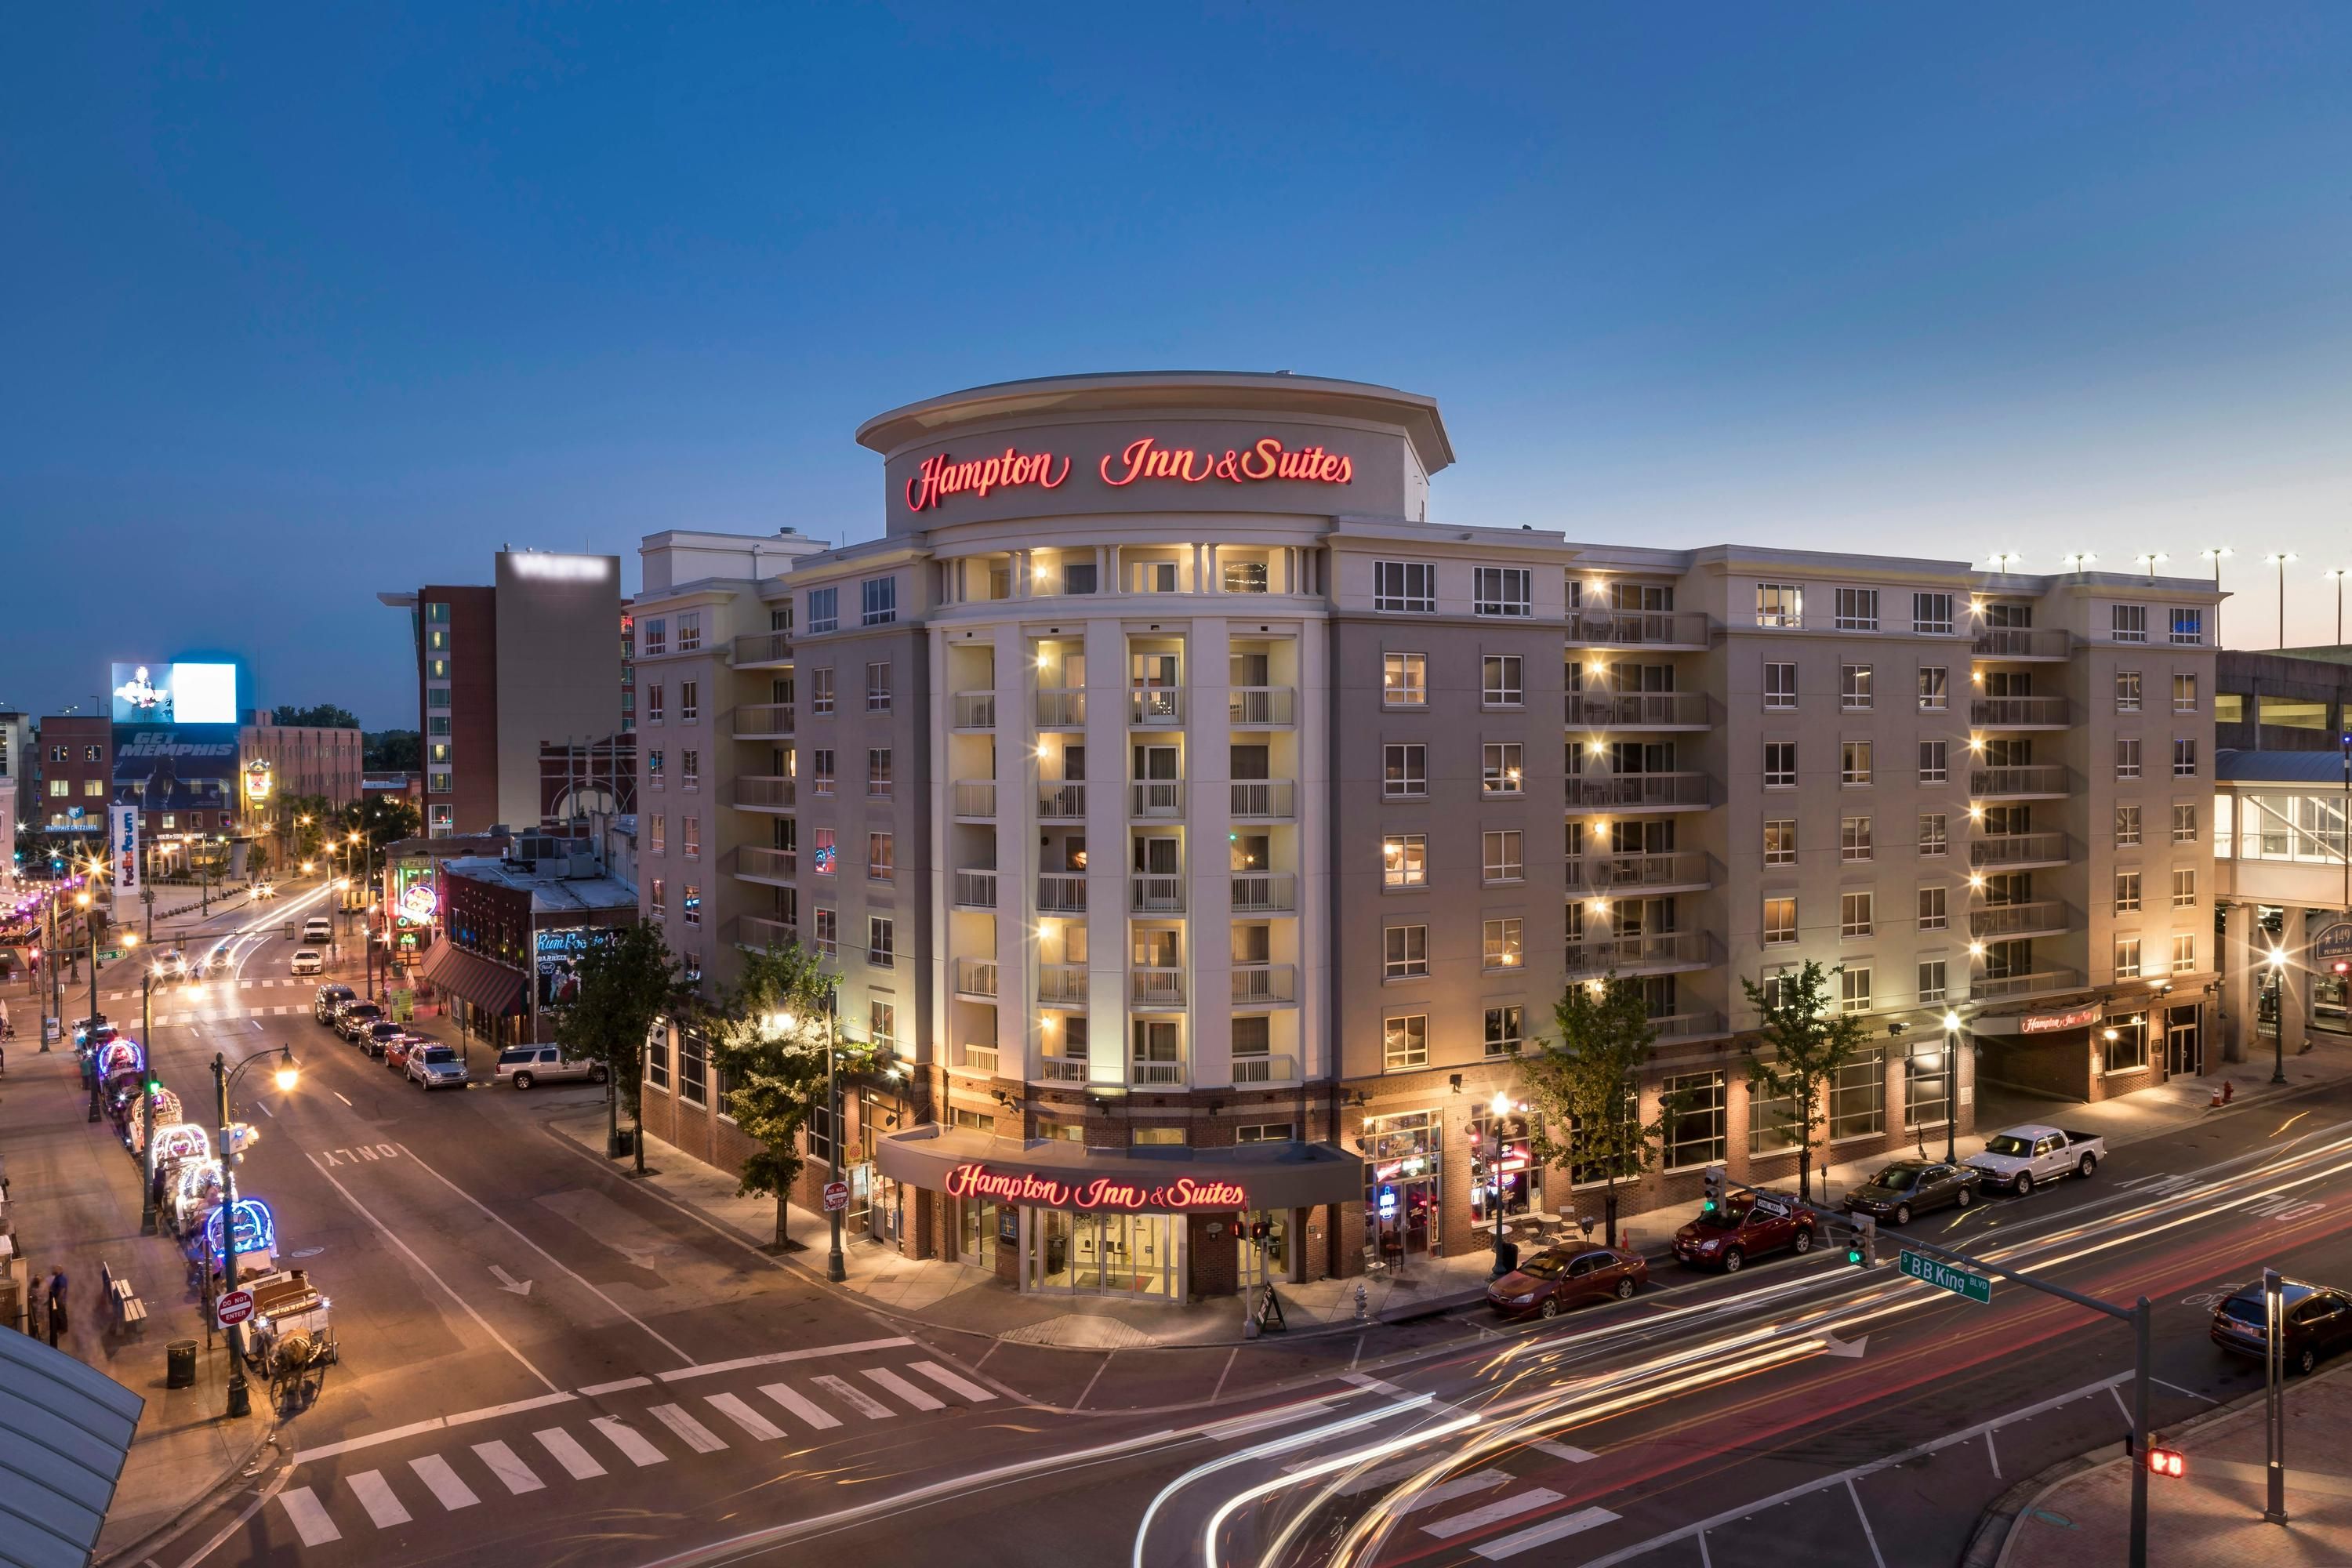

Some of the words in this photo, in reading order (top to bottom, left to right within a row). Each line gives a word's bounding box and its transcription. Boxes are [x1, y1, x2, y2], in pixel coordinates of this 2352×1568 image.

[906, 447, 1070, 513] Hampton
[1100, 437, 1214, 486] Inn
[1242, 437, 1352, 485] Suites
[133, 731, 179, 745] GET
[118, 744, 234, 757] MEMPHIS
[122, 812, 134, 887] FedExForum
[538, 933, 564, 950] Rum
[2335, 928, 2350, 944] 149
[2023, 1017, 2062, 1033] Hampton
[323, 1144, 398, 1167] ONLY
[945, 1163, 1069, 1207] Hampton
[1075, 1178, 1147, 1208] Inn
[1167, 1178, 1244, 1207] Suites
[1769, 1203, 1780, 1212] WAY
[1903, 1254, 1908, 1263] S
[1936, 1265, 1965, 1293] King
[1969, 1277, 1987, 1290] BLVD
[222, 1299, 231, 1308] DO
[234, 1295, 248, 1305] NOT
[225, 1309, 246, 1321] ENTER
